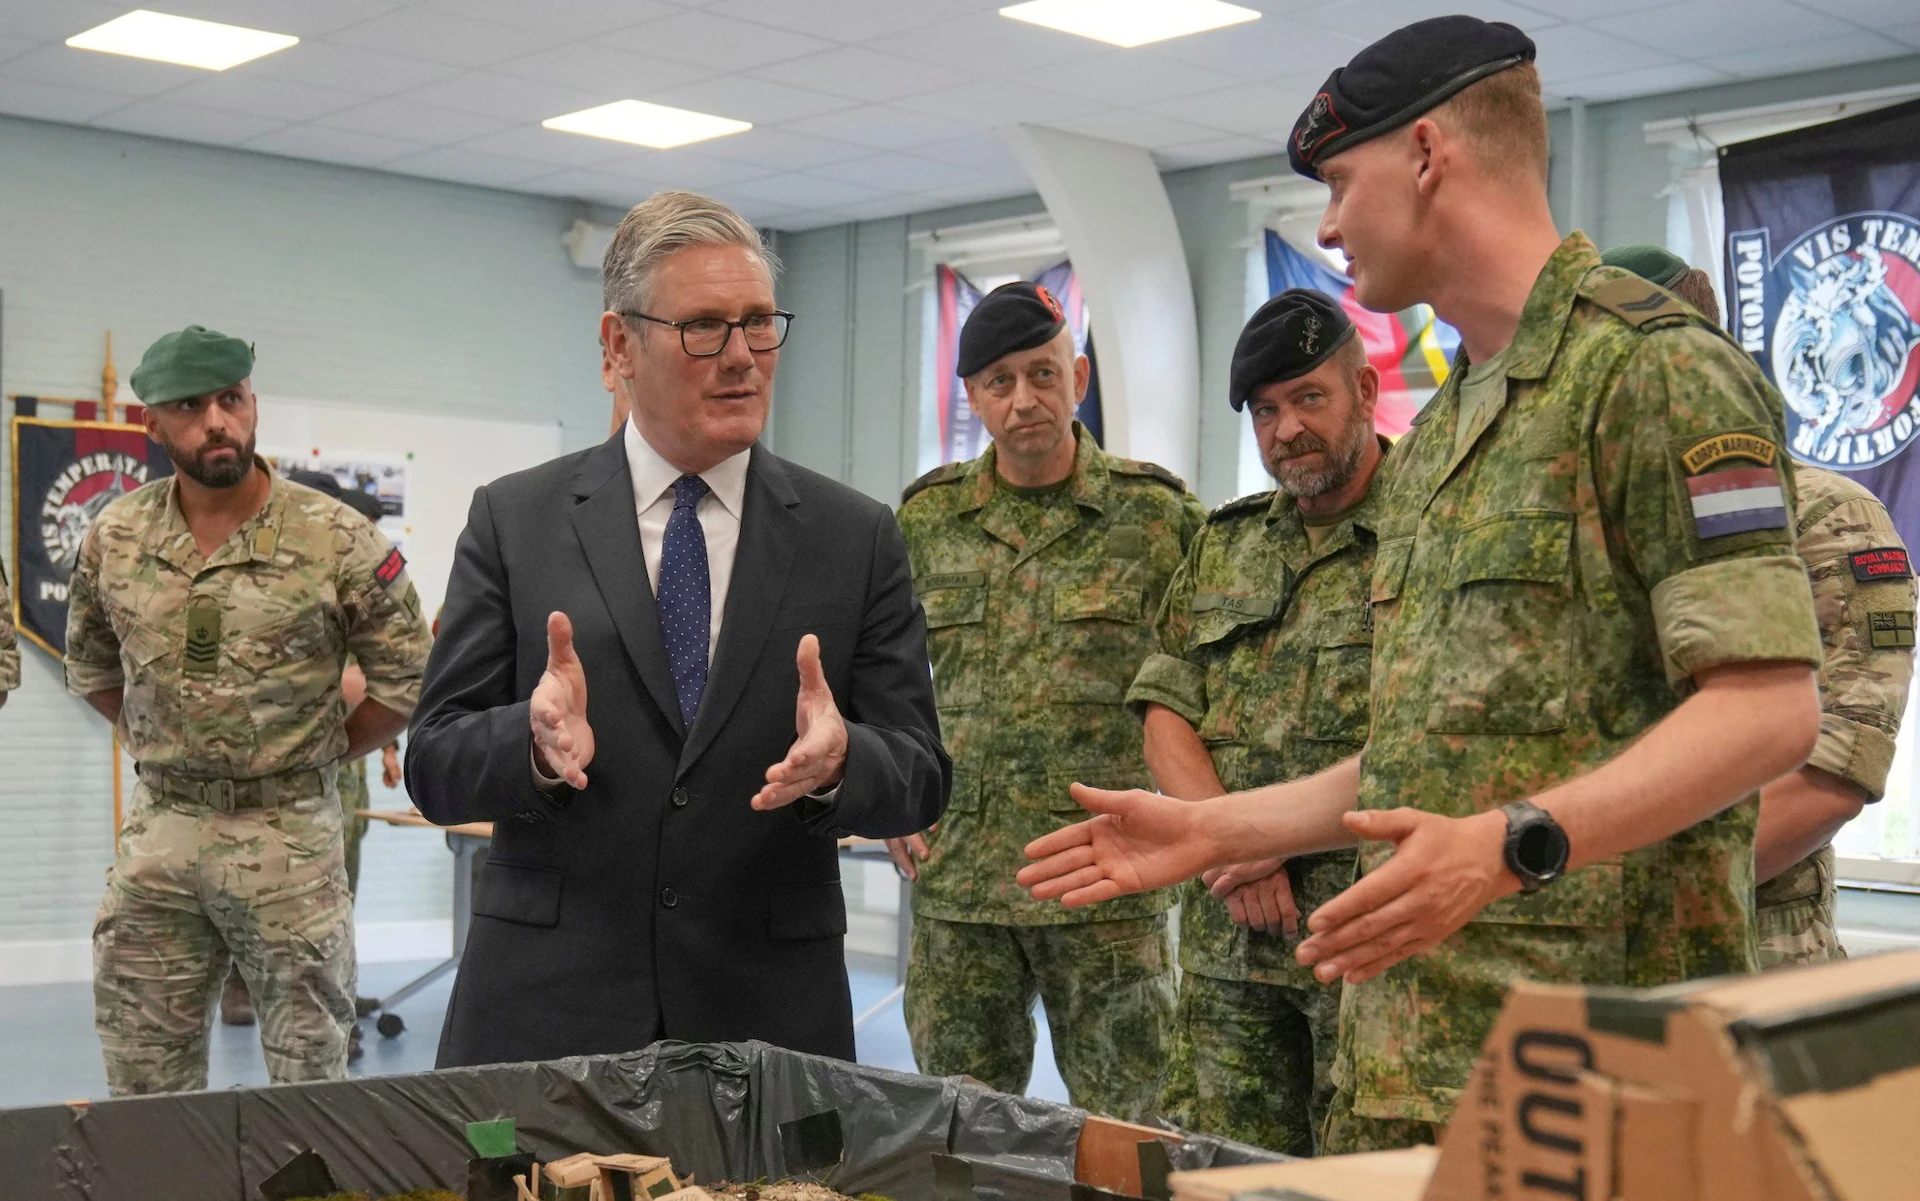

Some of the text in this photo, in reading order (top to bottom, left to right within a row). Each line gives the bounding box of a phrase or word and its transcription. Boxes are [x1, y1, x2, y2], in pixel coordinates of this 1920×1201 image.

[1793, 219, 1920, 269] VIS TEM
[1736, 238, 1765, 352] POTOM
[42, 452, 148, 517] TEMPERATA
[1853, 552, 1882, 566] ROYAL
[40, 581, 69, 602] PO
[1222, 597, 1244, 609] TAS
